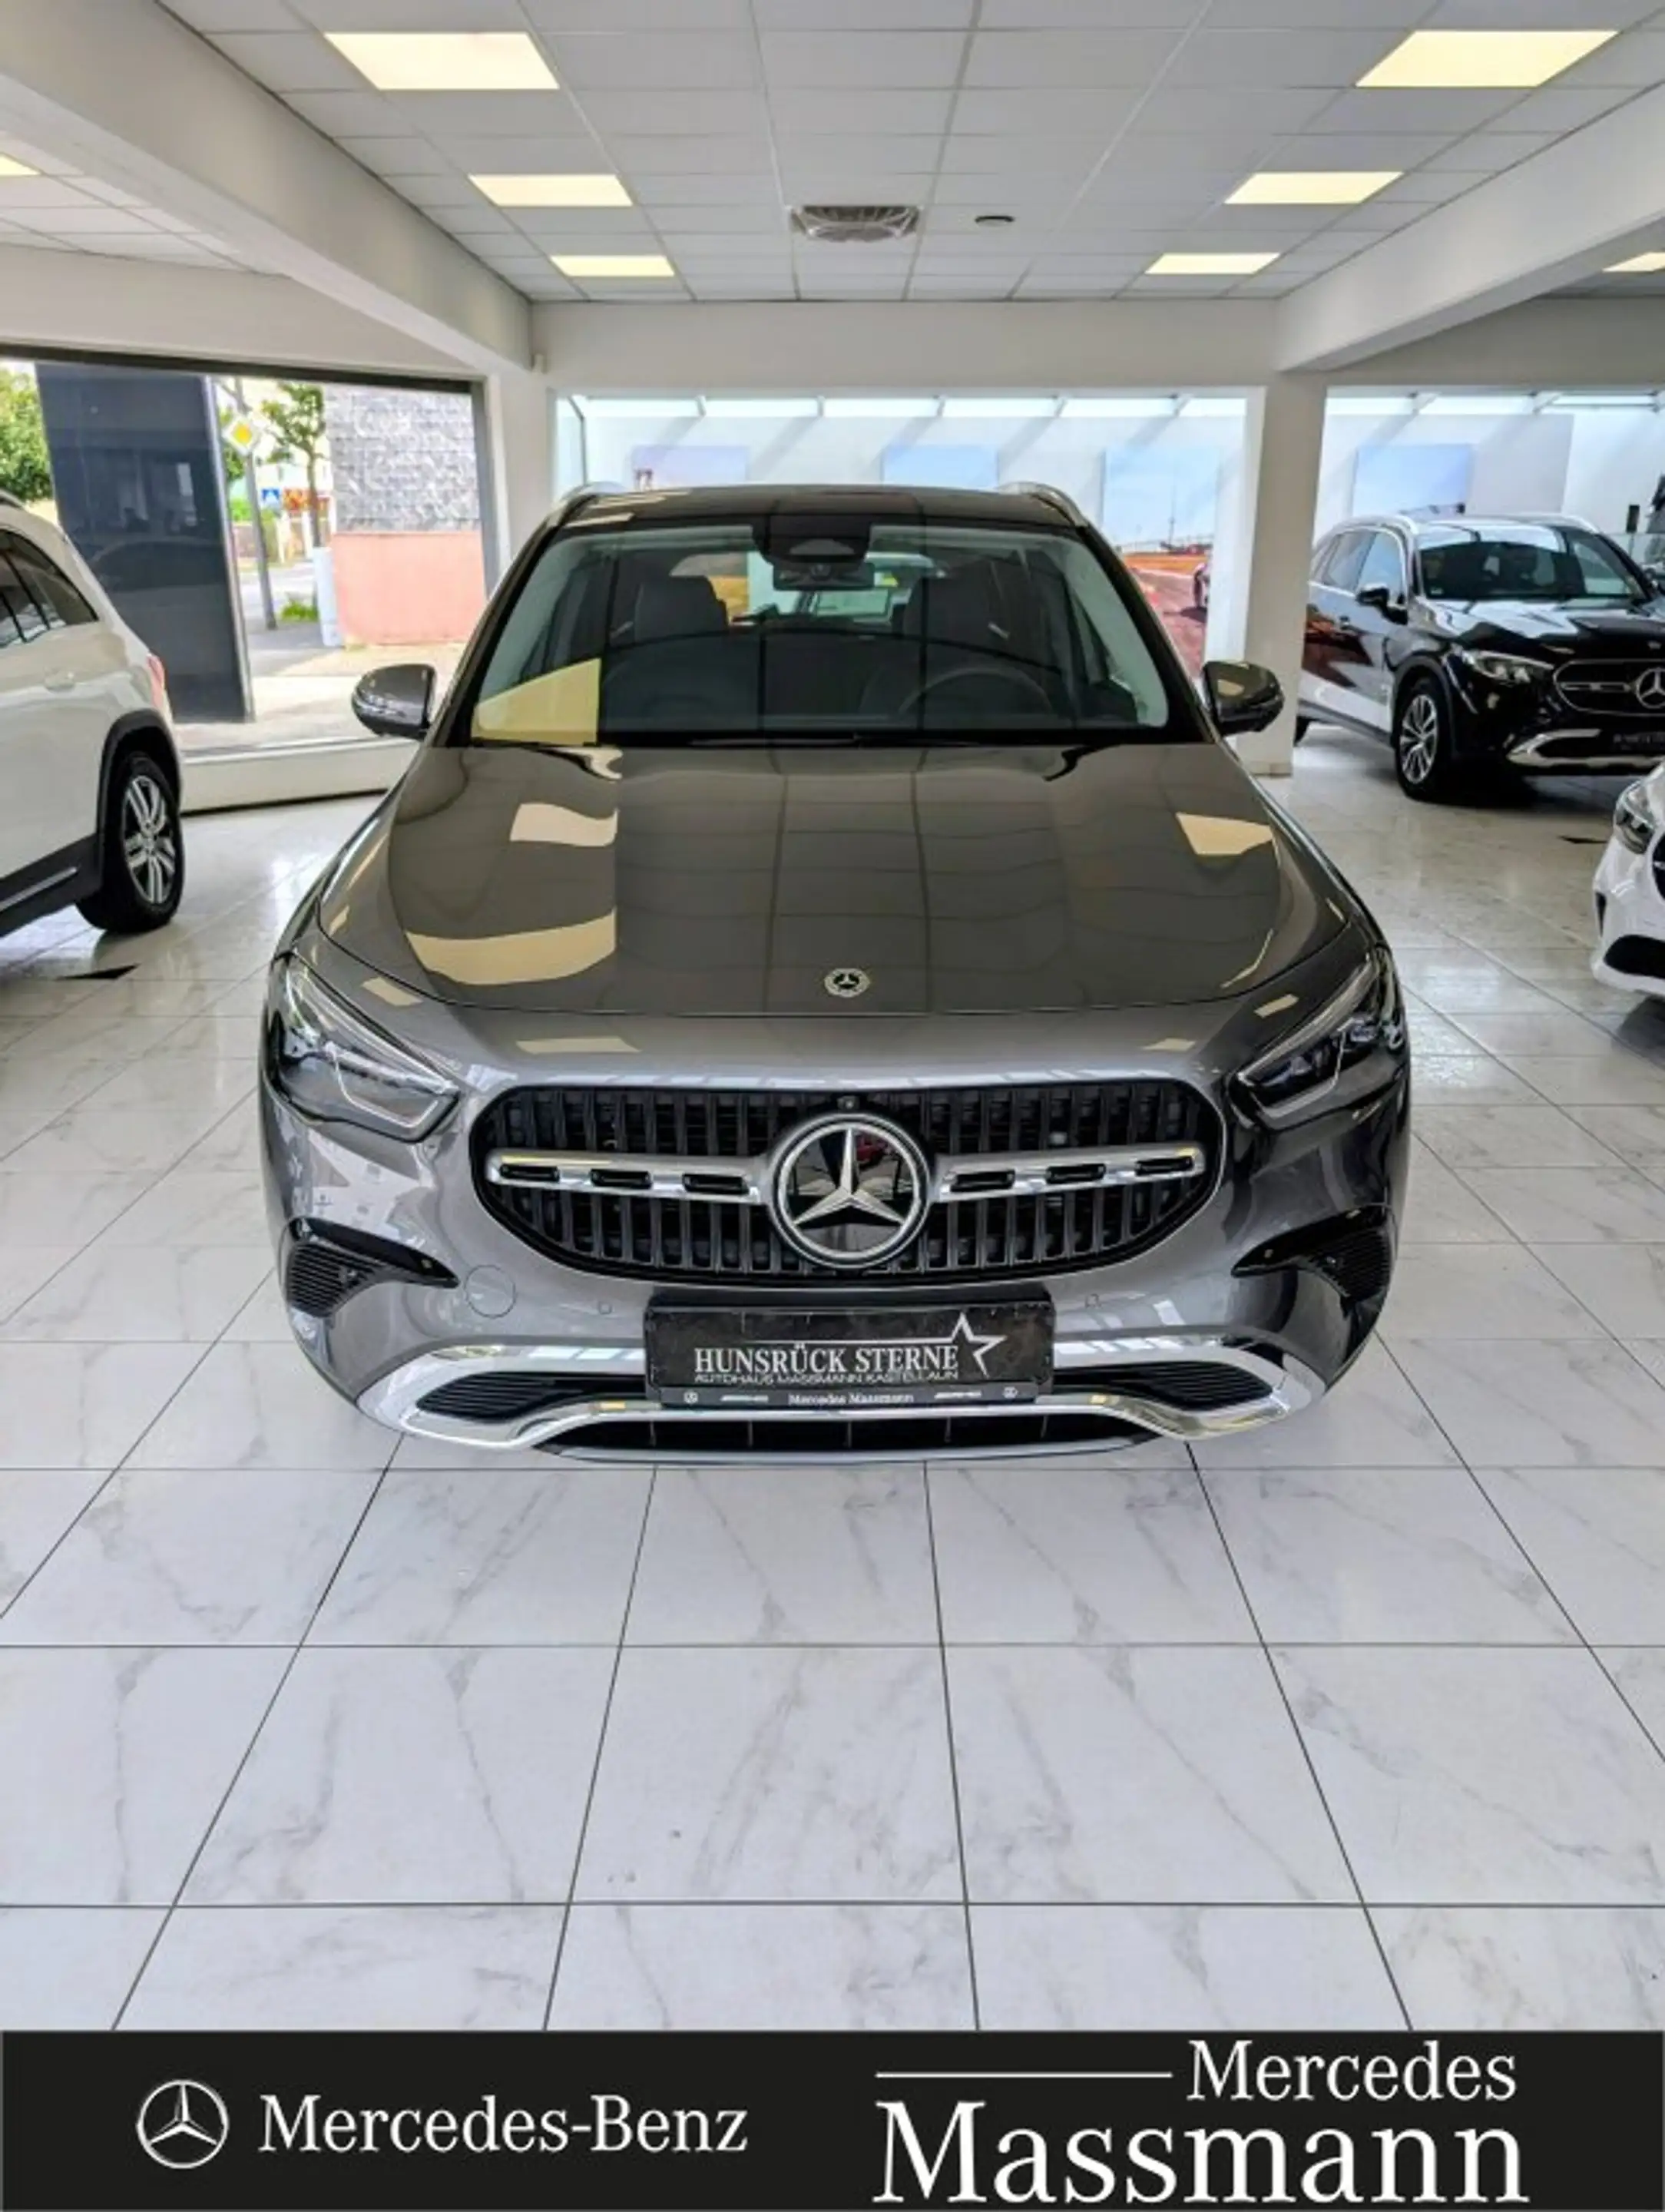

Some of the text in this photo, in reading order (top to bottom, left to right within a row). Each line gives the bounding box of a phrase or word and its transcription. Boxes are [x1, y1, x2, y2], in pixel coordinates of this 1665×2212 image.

[694, 1343, 959, 1373] HUNSRÜCK STERNE
[788, 1392, 846, 1406] Mercedes
